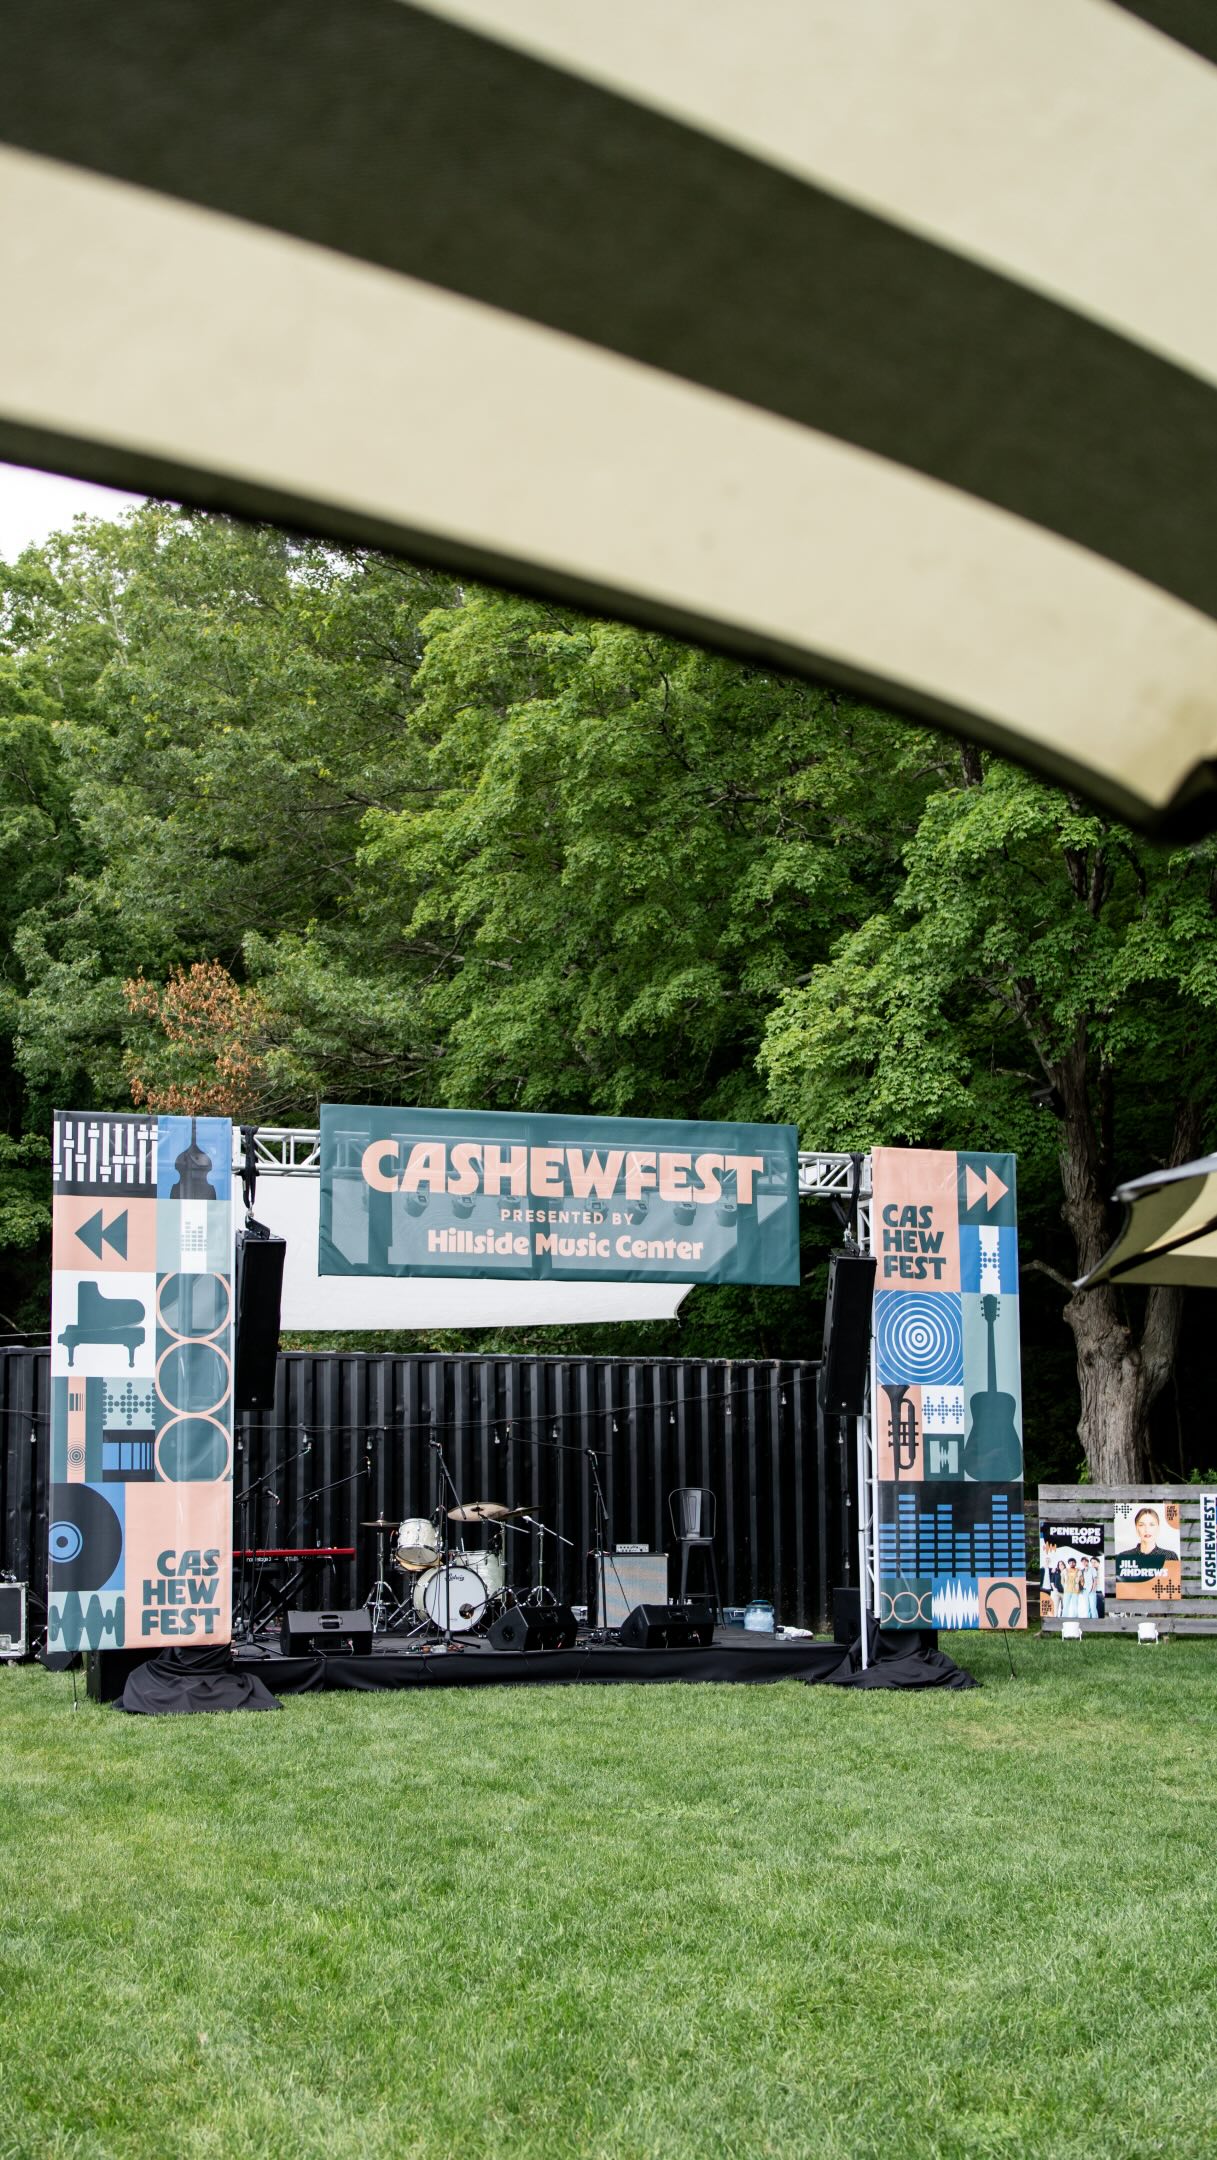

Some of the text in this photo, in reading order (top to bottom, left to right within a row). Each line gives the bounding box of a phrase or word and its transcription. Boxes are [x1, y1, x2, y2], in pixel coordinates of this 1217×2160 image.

[361, 1139, 764, 1205] CASHEWFEST
[500, 1208, 634, 1225] PRESENTED BY
[882, 1204, 933, 1229] CAS
[427, 1227, 704, 1260] Hillside Music Center
[883, 1229, 944, 1254] HEW
[884, 1255, 946, 1280] FEST
[1050, 1526, 1101, 1536] PENELOPE
[1071, 1535, 1101, 1545] ROAD
[1204, 1497, 1216, 1588] CASHEWFEST
[157, 1549, 220, 1577] CAS
[1119, 1559, 1139, 1569] JILL
[1119, 1568, 1169, 1577] ANDREWS
[142, 1578, 220, 1605] HEW
[142, 1608, 221, 1636] FEST
